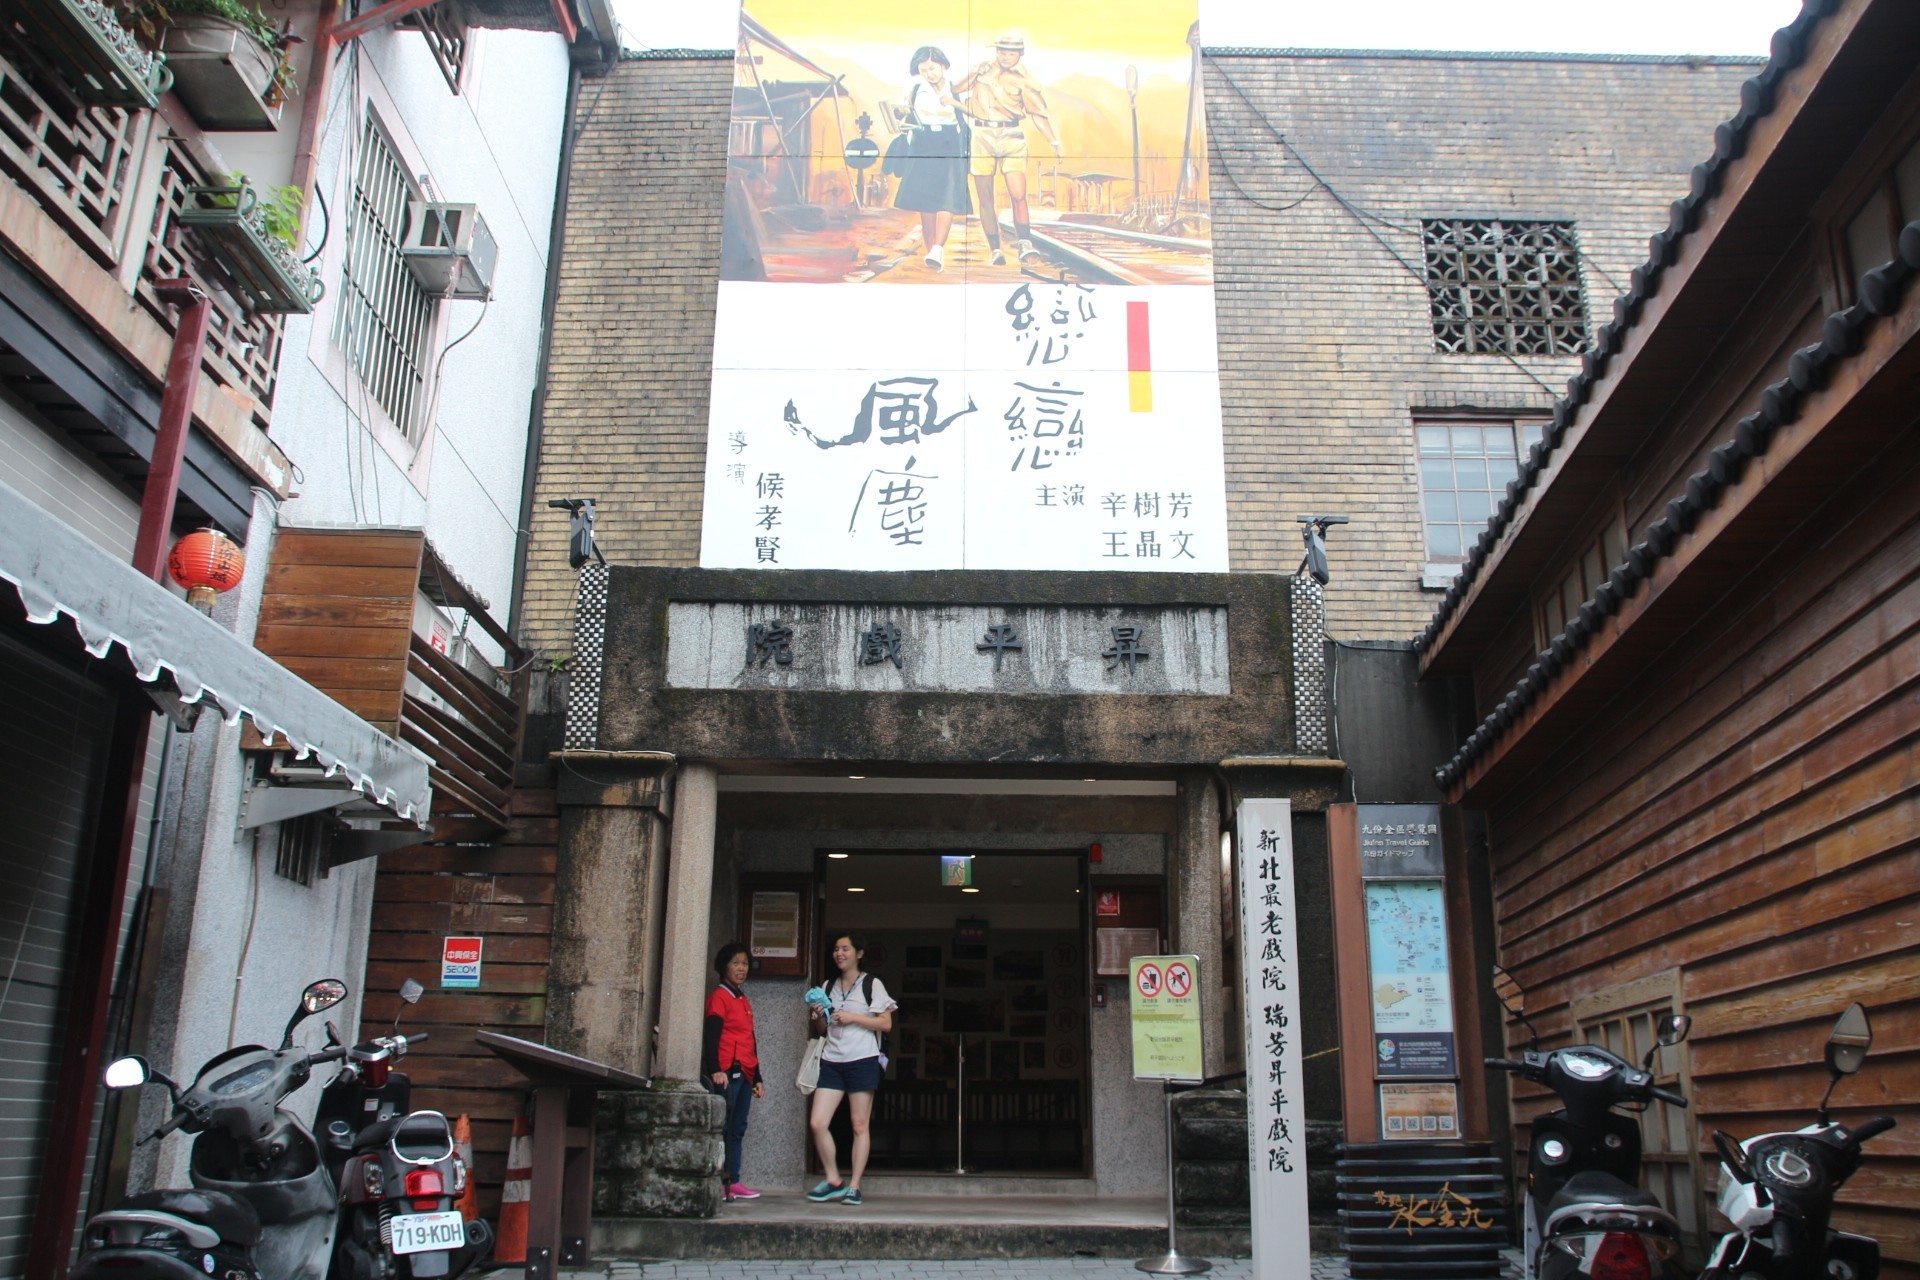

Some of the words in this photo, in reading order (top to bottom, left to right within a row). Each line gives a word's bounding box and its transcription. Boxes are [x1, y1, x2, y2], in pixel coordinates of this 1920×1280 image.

[727, 430, 748, 485] 導演
[784, 377, 978, 545] 風塵
[1035, 484, 1085, 506] 主演
[1101, 492, 1193, 518] 辛樹芳
[1102, 530, 1196, 559] 王晶文
[1386, 838, 1407, 846] Travel
[1408, 838, 1430, 846] Guide
[446, 965, 477, 974] SECOM
